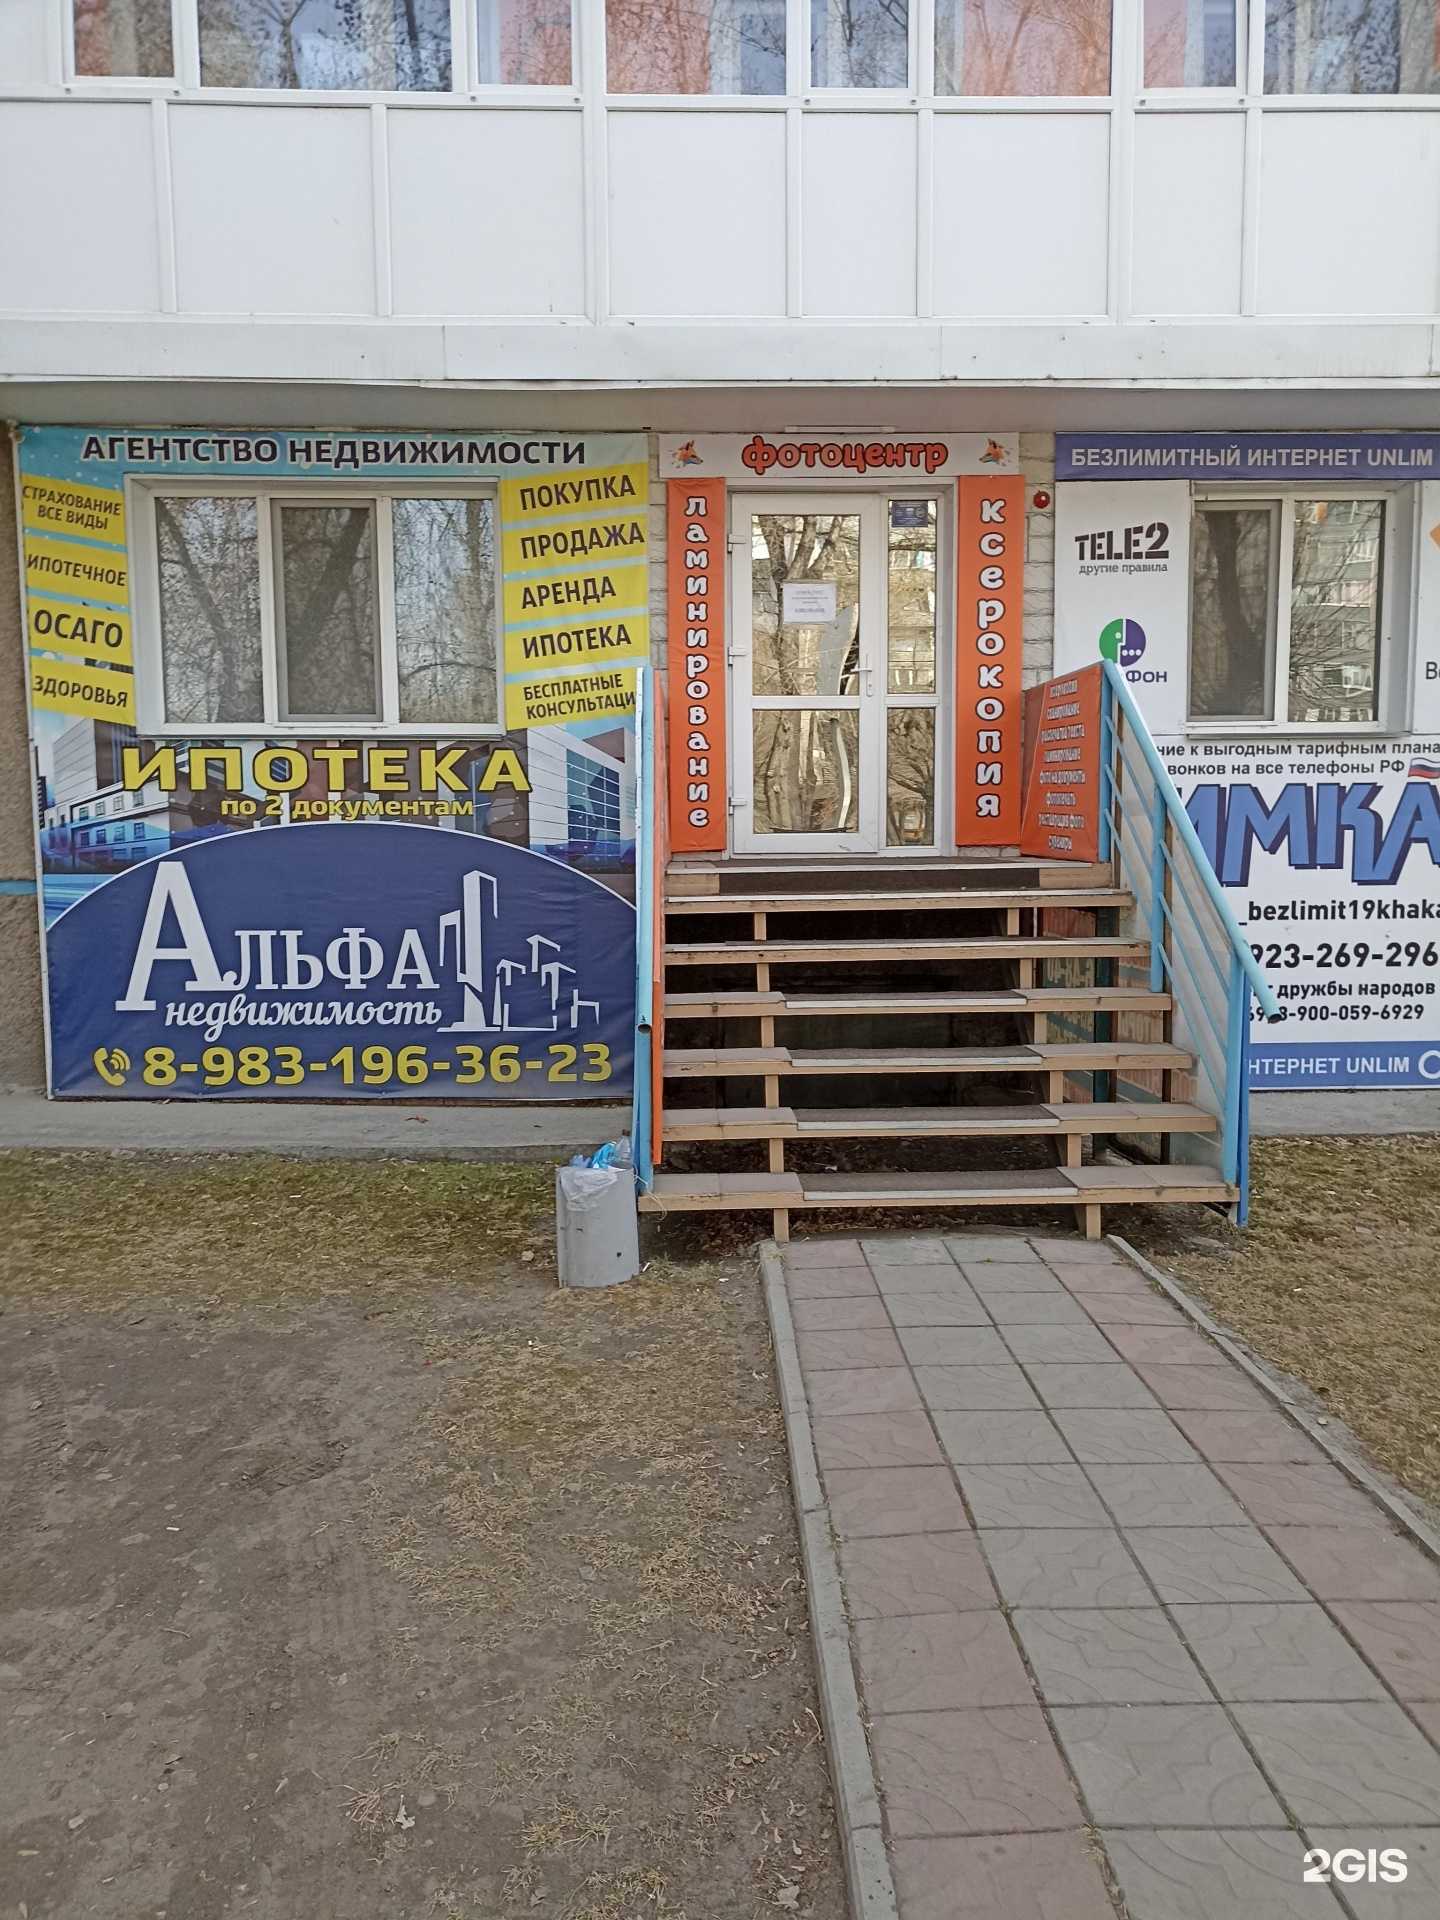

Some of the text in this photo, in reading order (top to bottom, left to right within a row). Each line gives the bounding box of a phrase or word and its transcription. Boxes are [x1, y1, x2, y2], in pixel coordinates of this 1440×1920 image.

[82, 436, 586, 468] АГЕНТСТВО НЕДВИЖИМОСТИ
[742, 436, 949, 474] фотоцентр
[1071, 445, 1433, 466] БЕЗЛИМИТНЫЙ ИНТЕРНЕТ UNLIM
[22, 485, 122, 516] СТРАХОВАНИЕ
[519, 474, 636, 511] ПОКУПКА
[37, 505, 109, 530] ВСЕ ВИДЫ
[520, 522, 645, 560] ПРОДАЖА
[1074, 522, 1169, 560] TELE2
[26, 554, 127, 587] ИПОТЕЧНОЕ
[1079, 563, 1168, 575] другие правила
[521, 576, 617, 610] АРЕНДА
[34, 608, 123, 648] ОСАГО
[522, 624, 632, 659] ИПОТЕКА
[523, 673, 623, 700] БЕСПЛАТНЫЕ
[1425, 662, 1440, 680] В
[33, 675, 128, 707] ЗДОРОВЬЯ
[526, 691, 636, 719] КОНСУЛЬТАЦИ
[1190, 745, 1199, 756] к
[1203, 744, 1292, 757] выгодным
[1296, 742, 1387, 757] тарифным
[122, 747, 532, 793] ИПОТЕКА
[1168, 759, 1405, 776] вонков на все телефоны РФ
[221, 796, 474, 820] по 2 документам
[1277, 982, 1352, 1000] дружбы
[1358, 983, 1435, 998] народов
[165, 994, 442, 1042] недвижимость
[143, 1044, 613, 1086] 8-983-196-36-23
[1347, 1057, 1409, 1074] UNLIM
